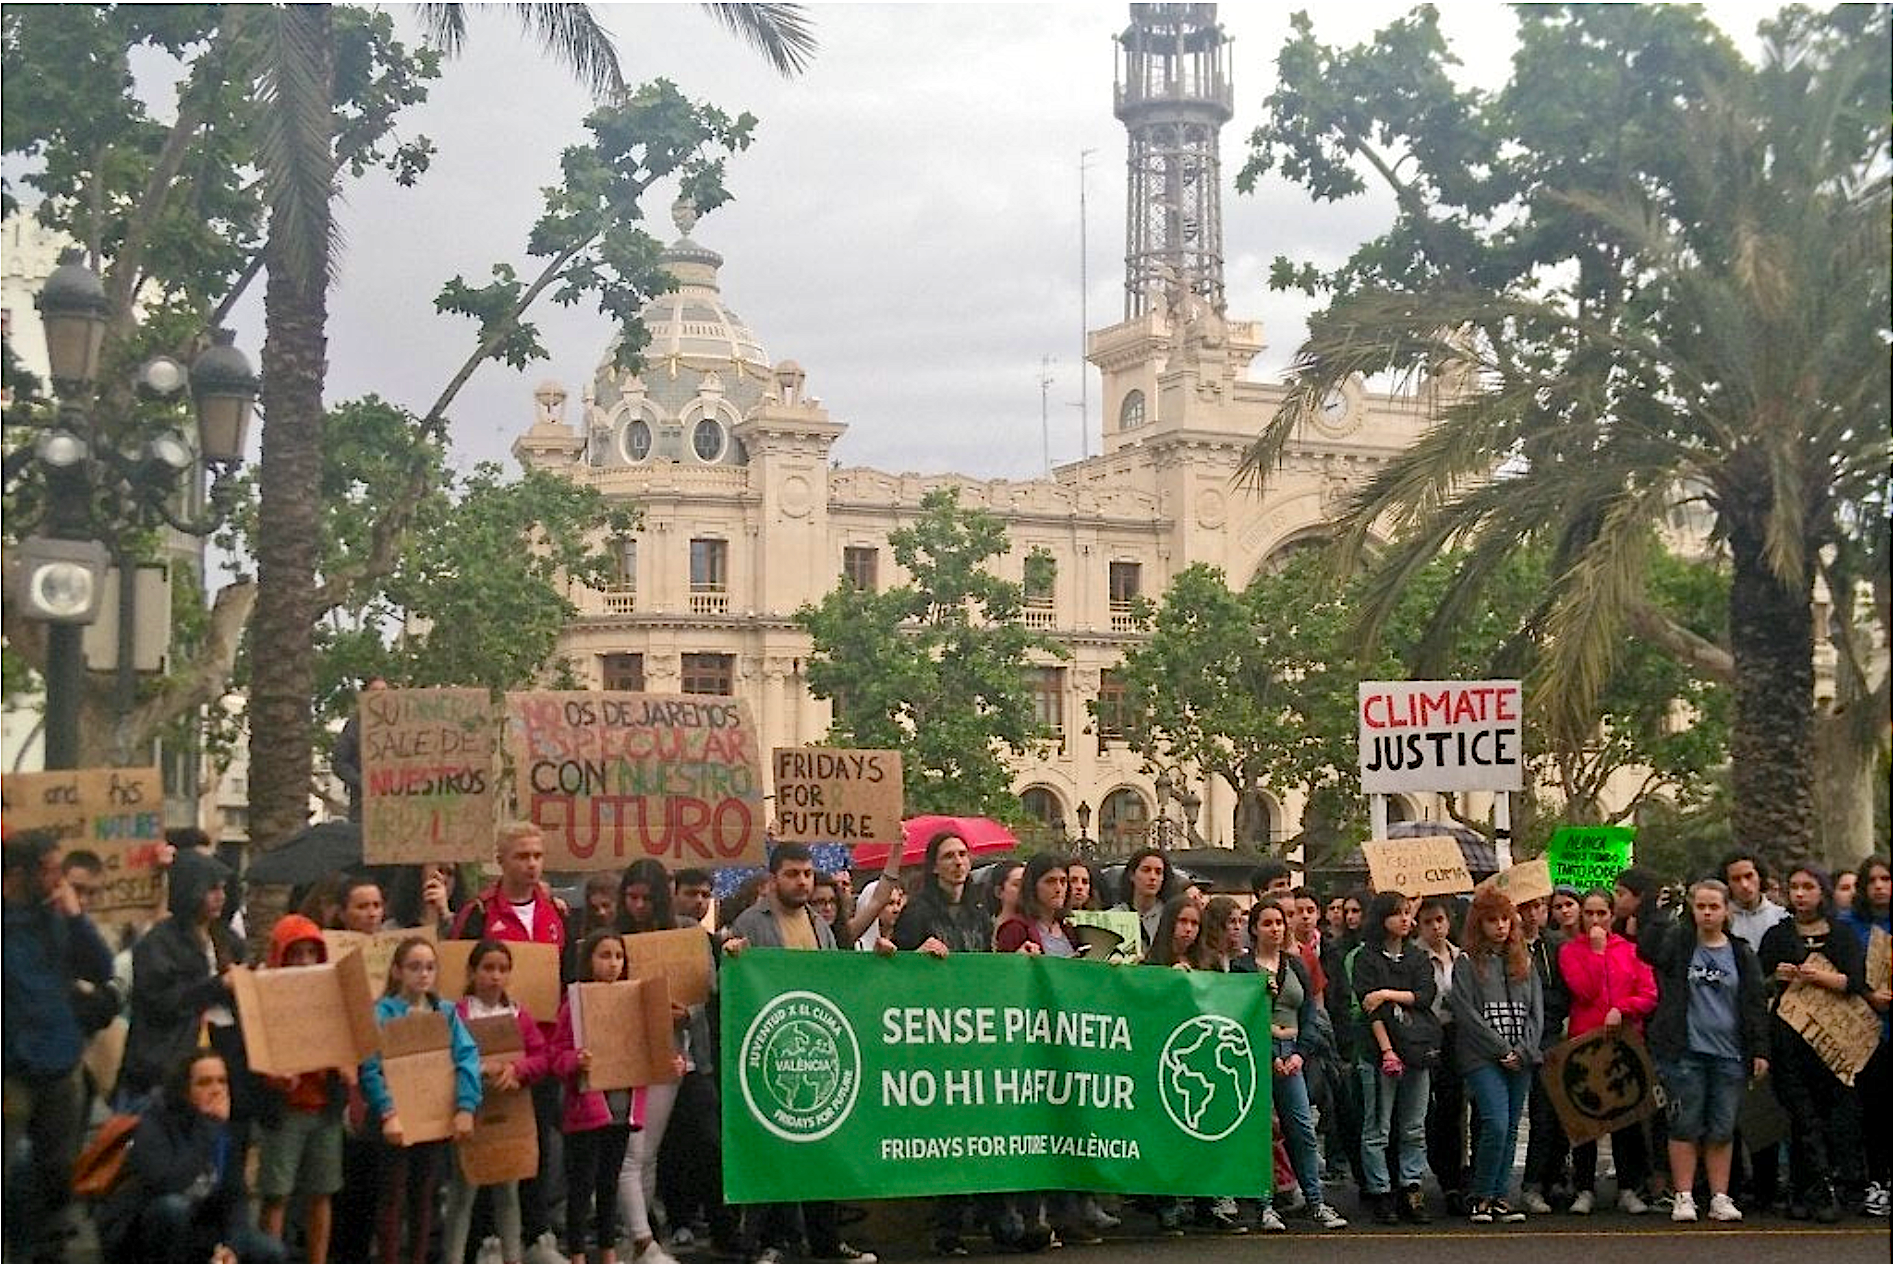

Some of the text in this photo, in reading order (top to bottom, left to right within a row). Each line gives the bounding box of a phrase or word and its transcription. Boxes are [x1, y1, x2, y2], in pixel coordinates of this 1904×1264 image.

[368, 692, 399, 728] SU
[523, 700, 741, 728] NO OS DEJAREMOS
[1364, 687, 1517, 729] CLIMATE
[367, 728, 479, 760] SALE DE
[528, 726, 749, 764] ESPECULAR
[1366, 729, 1516, 771] JUSTICE
[369, 762, 487, 797] NUESTROS
[530, 758, 751, 797] CON NUESTRO
[780, 753, 883, 783] FRIDAYS
[780, 784, 824, 807] FOR
[531, 795, 752, 859] FUTURO
[780, 811, 874, 838] FUTURE
[800, 1004, 811, 1016] EL
[813, 1007, 842, 1036] CLIMA
[882, 1007, 1133, 1051] SENSE PLANETA
[881, 1069, 937, 1107] NO
[944, 1069, 985, 1105] HI
[774, 1109, 815, 1128] FRIDAYS
[816, 1107, 835, 1125] FOR
[881, 1132, 1140, 1160] FRIDAYS FOR FUTURE VALÈNCIA
